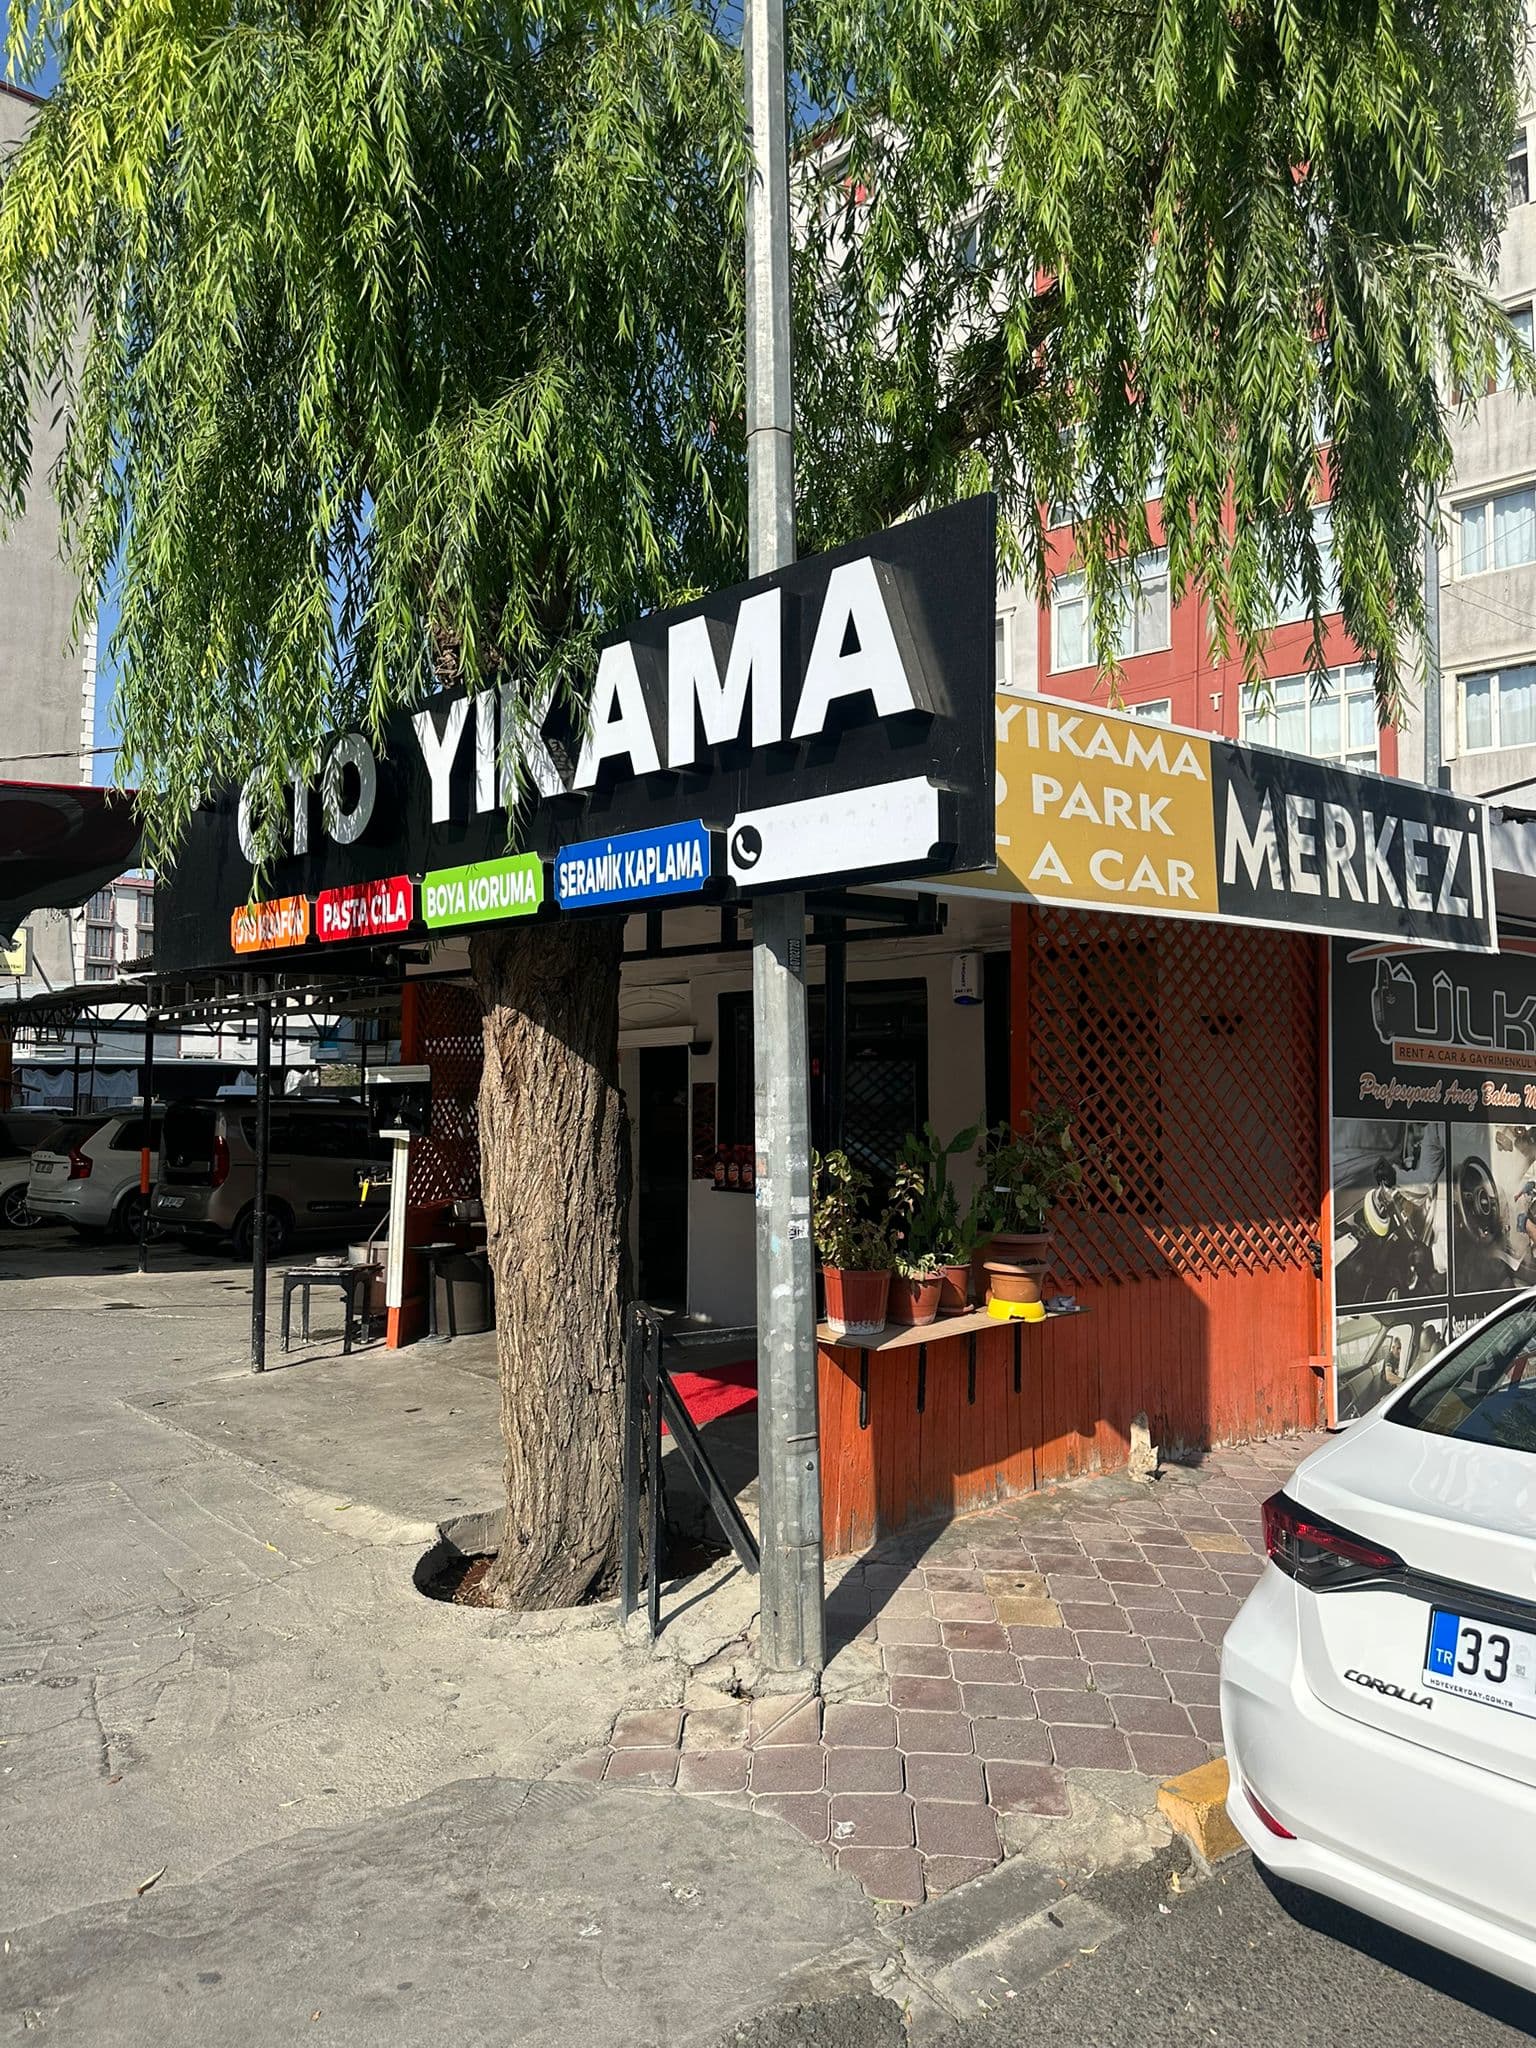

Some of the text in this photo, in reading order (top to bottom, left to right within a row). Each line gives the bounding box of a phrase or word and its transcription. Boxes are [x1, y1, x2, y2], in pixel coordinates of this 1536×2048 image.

[410, 556, 916, 824] YIKAMA
[996, 703, 1208, 782] YIKAMA
[1031, 773, 1176, 837] PARK
[559, 839, 704, 899] SERAMİK KAPLAMA
[1028, 840, 1200, 900] A CAR
[1223, 779, 1484, 920] MERKEZİ
[323, 884, 407, 933] PASTA CİLA
[426, 868, 537, 919] BOYA KORUMA
[1399, 1047, 1425, 1059] RENT
[1428, 1050, 1436, 1060] A
[1438, 1051, 1458, 1062] CAR
[1359, 1071, 1443, 1110] Profesyonel
[1435, 1627, 1511, 1684] TR 33
[1343, 1669, 1434, 1710] COROLLA
